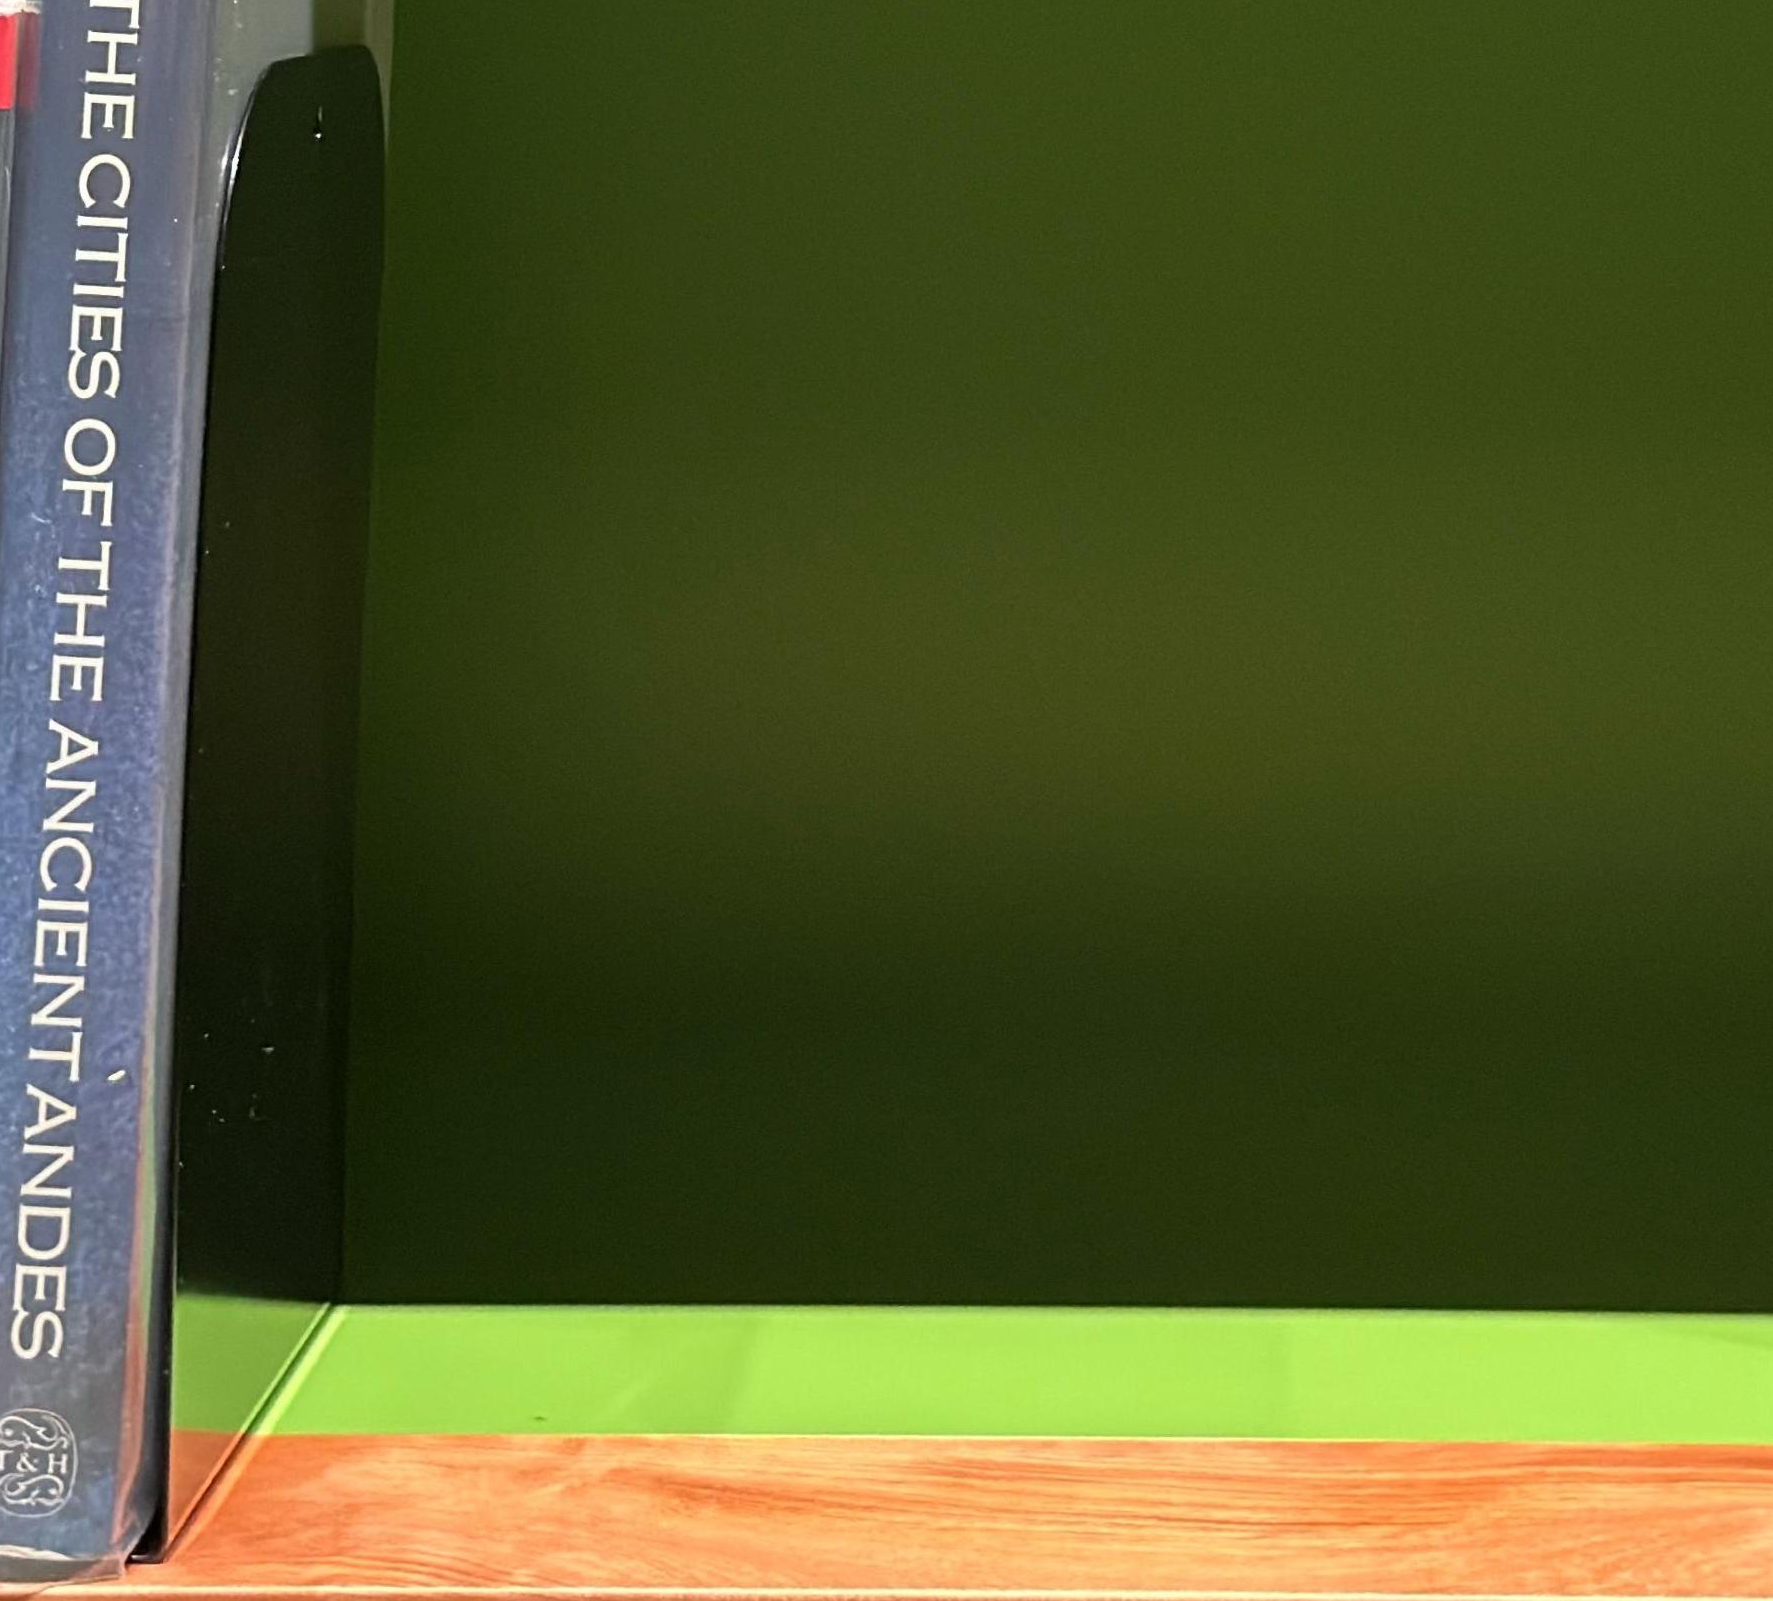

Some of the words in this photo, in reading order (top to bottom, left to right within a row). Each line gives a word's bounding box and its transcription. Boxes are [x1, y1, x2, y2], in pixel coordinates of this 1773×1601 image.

[67, 153, 131, 399] CITIES
[62, 418, 116, 527] OF
[49, 540, 113, 702] THE
[28, 718, 99, 1083] ANCIENT
[10, 1083, 77, 1360] ANDES
